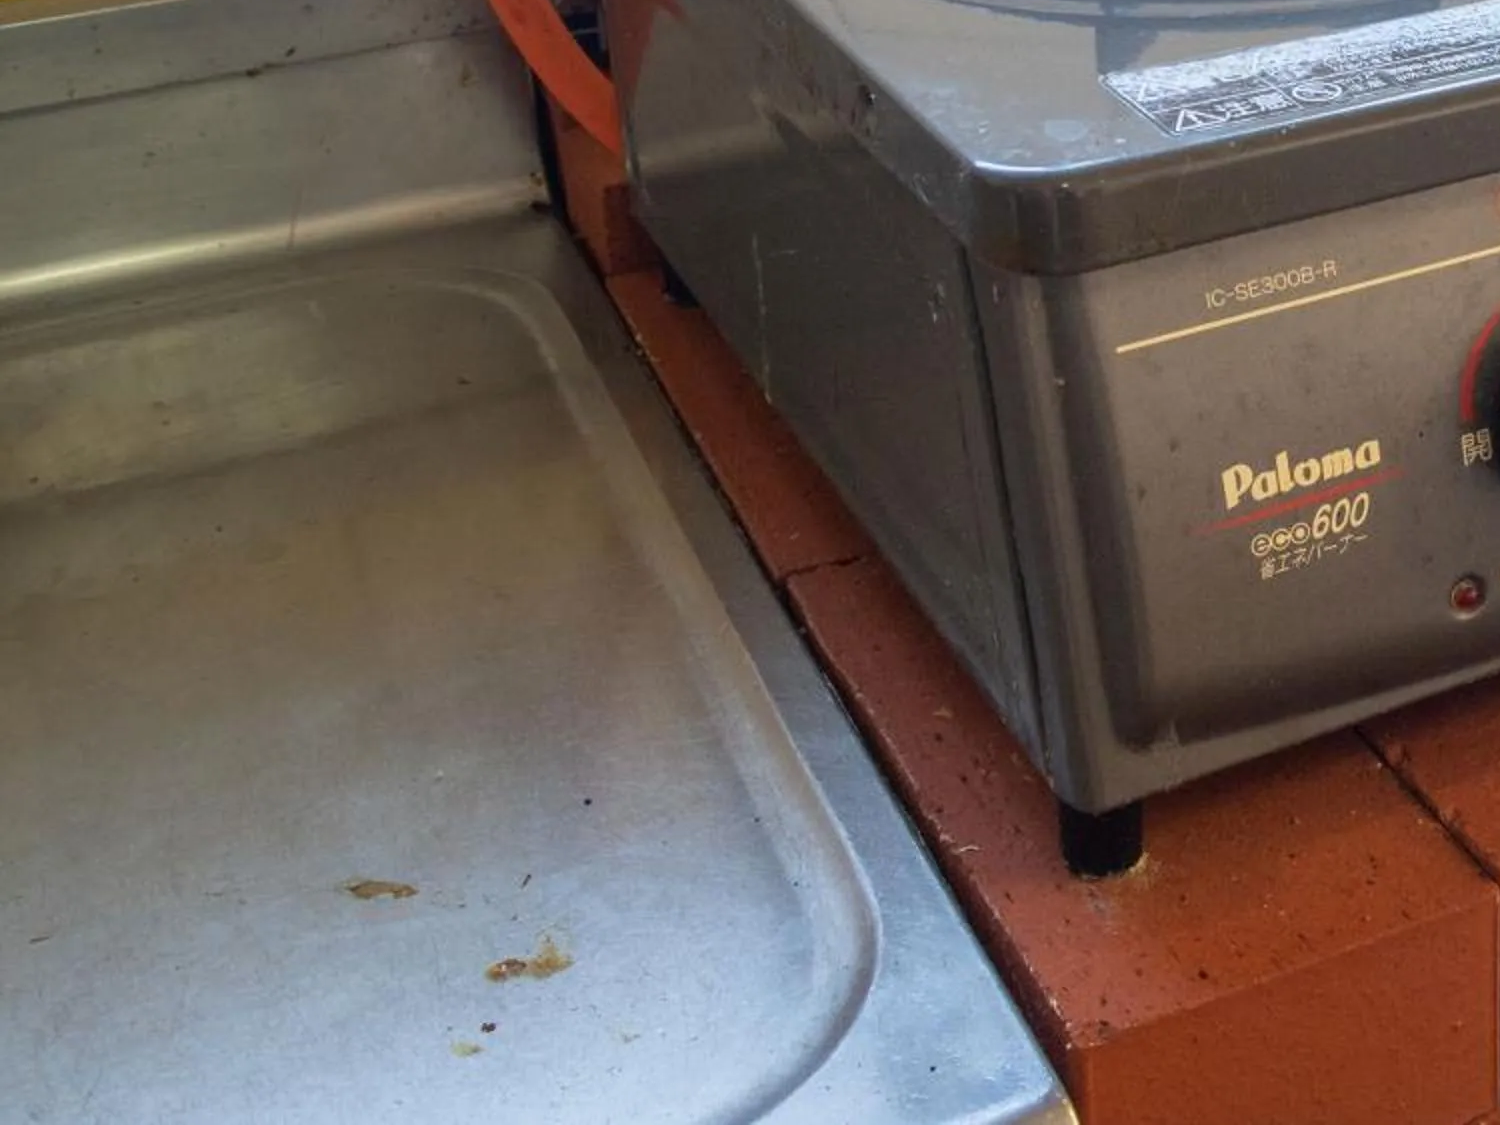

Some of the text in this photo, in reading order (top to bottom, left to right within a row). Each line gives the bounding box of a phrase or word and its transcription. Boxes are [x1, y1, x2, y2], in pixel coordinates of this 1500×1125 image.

[1205, 260, 1337, 309] IC-SE300B-R
[1461, 428, 1493, 467] 開
[1221, 439, 1381, 511] Paloma
